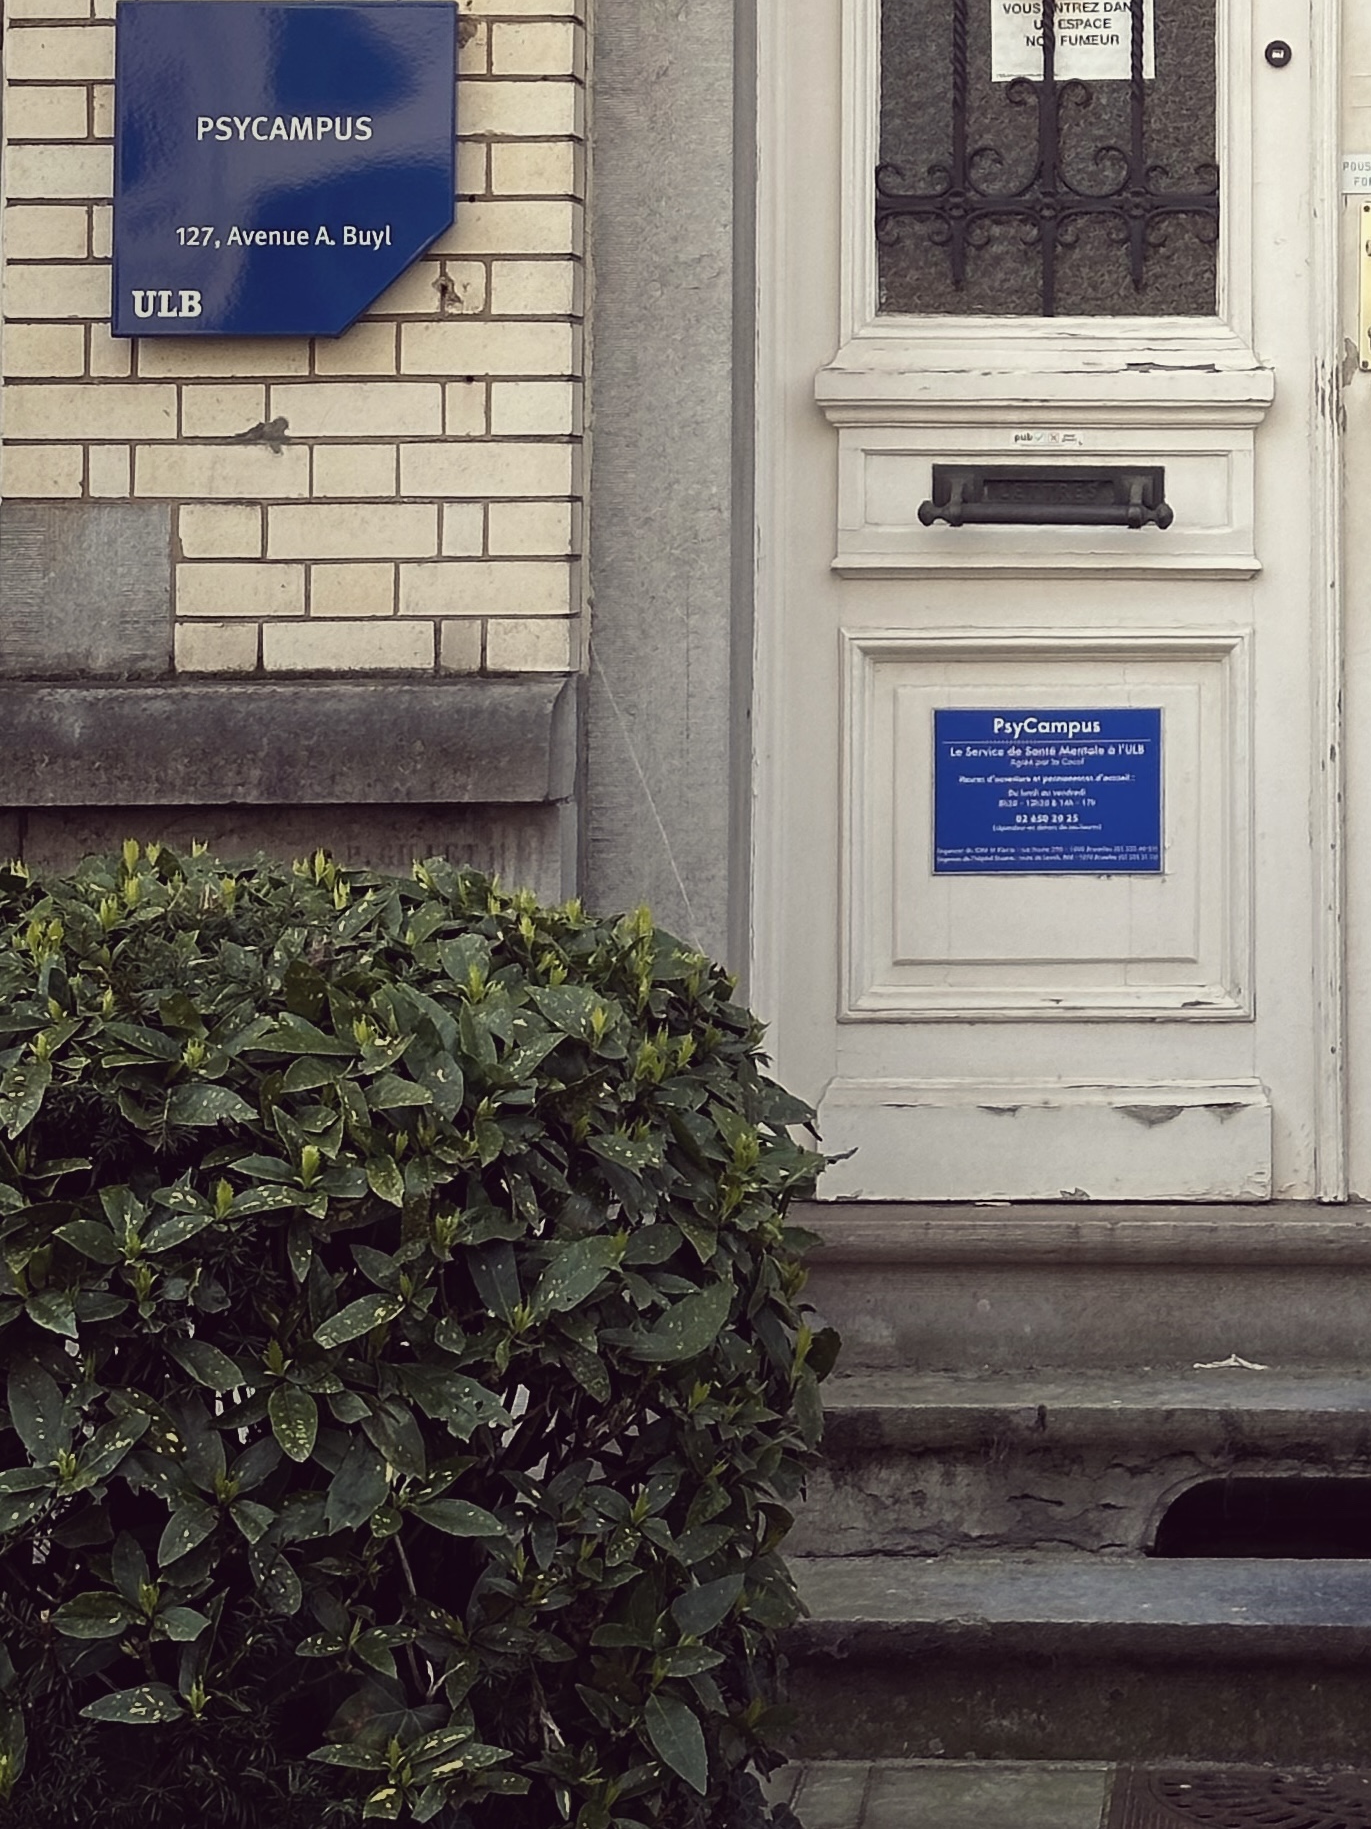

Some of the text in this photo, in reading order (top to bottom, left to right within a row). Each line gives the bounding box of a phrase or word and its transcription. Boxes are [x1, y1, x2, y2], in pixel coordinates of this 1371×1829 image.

[1003, 1, 1132, 14] VOUS NTREZ DAN
[1058, 18, 1112, 30] ESPACE
[1026, 34, 1119, 47] NO FUMEUR
[197, 116, 373, 141] PSYCAMPUS
[176, 225, 392, 251] 127, Avenue A. Buyl
[132, 290, 203, 318] ULB
[1000, 482, 1097, 501] LETTRES
[993, 717, 1101, 739] PsyCampus
[950, 743, 1145, 757] Le Service de Santé Mentale à l'ULB
[1015, 814, 1079, 823] 02 650 20 25
